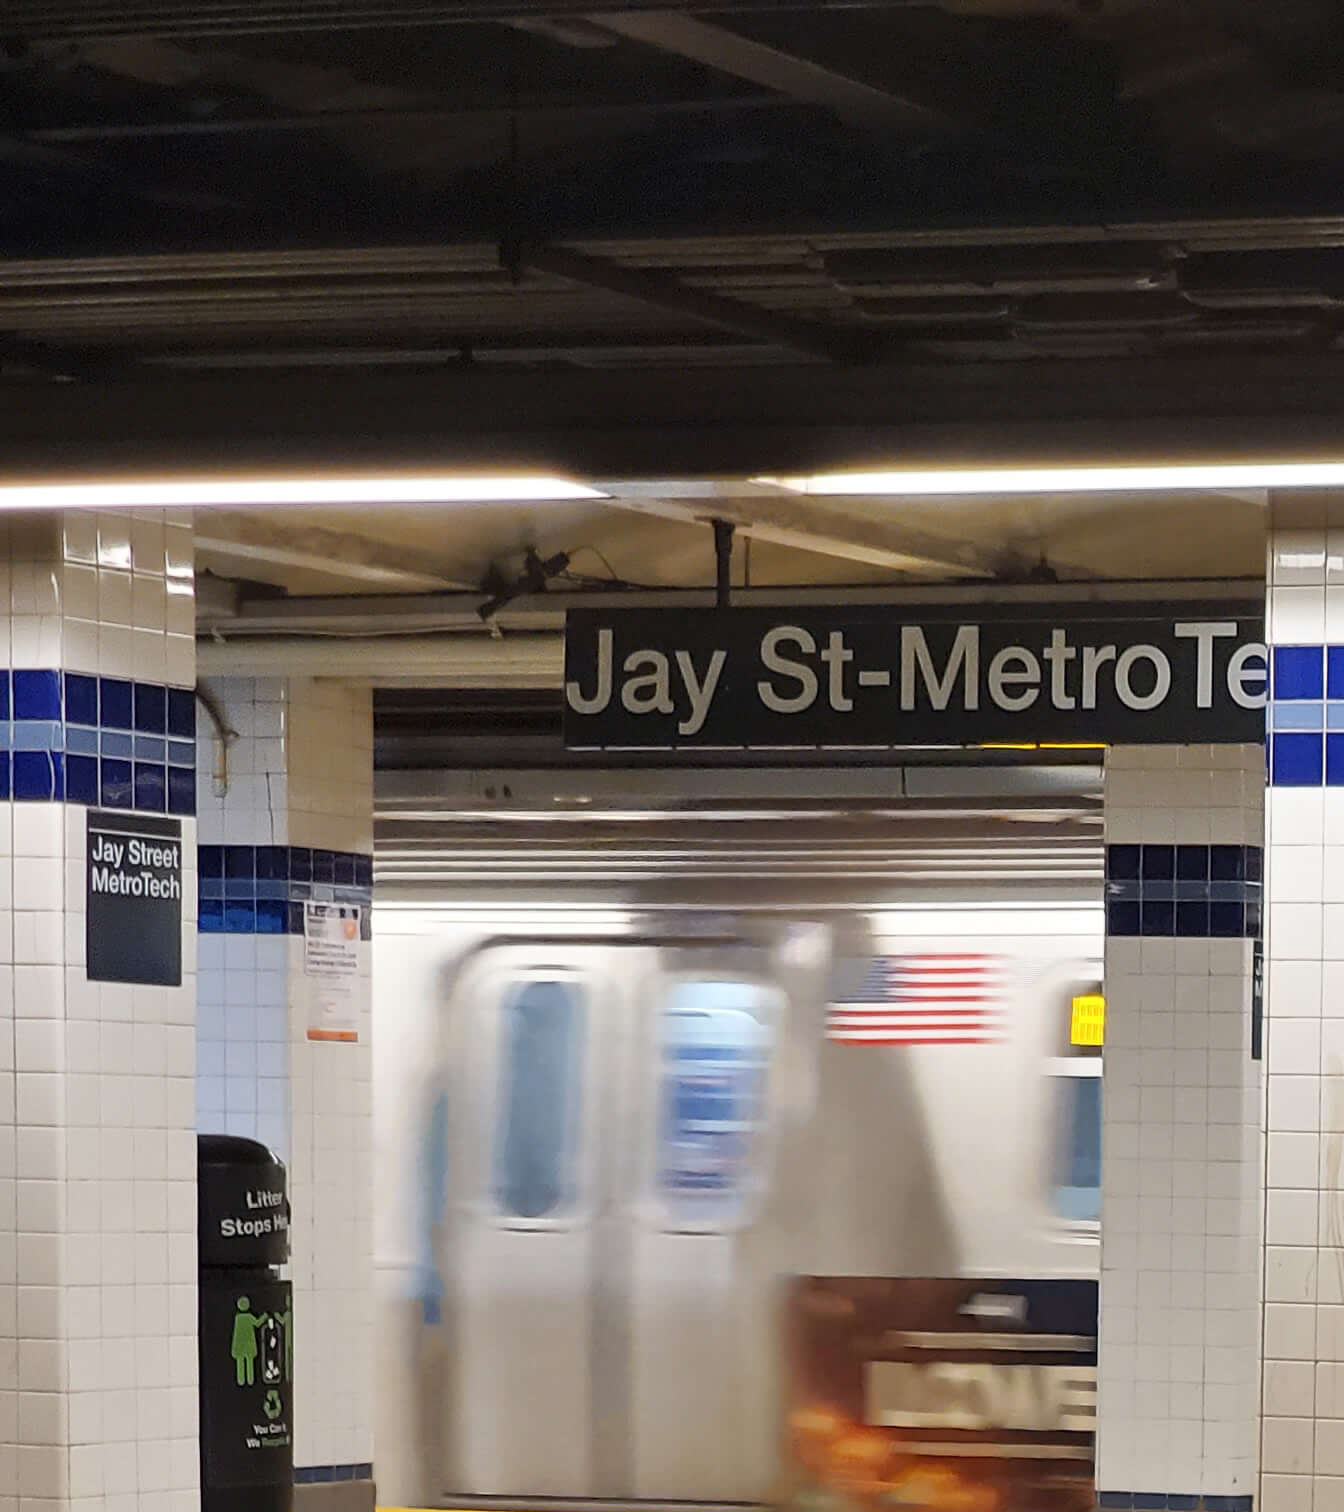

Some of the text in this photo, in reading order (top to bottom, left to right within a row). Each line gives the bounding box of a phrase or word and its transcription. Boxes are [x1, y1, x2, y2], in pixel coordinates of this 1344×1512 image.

[566, 628, 727, 735] Jay
[92, 835, 178, 869] Jay Street
[92, 866, 180, 899] MetroTech
[221, 1217, 272, 1238] Stops
